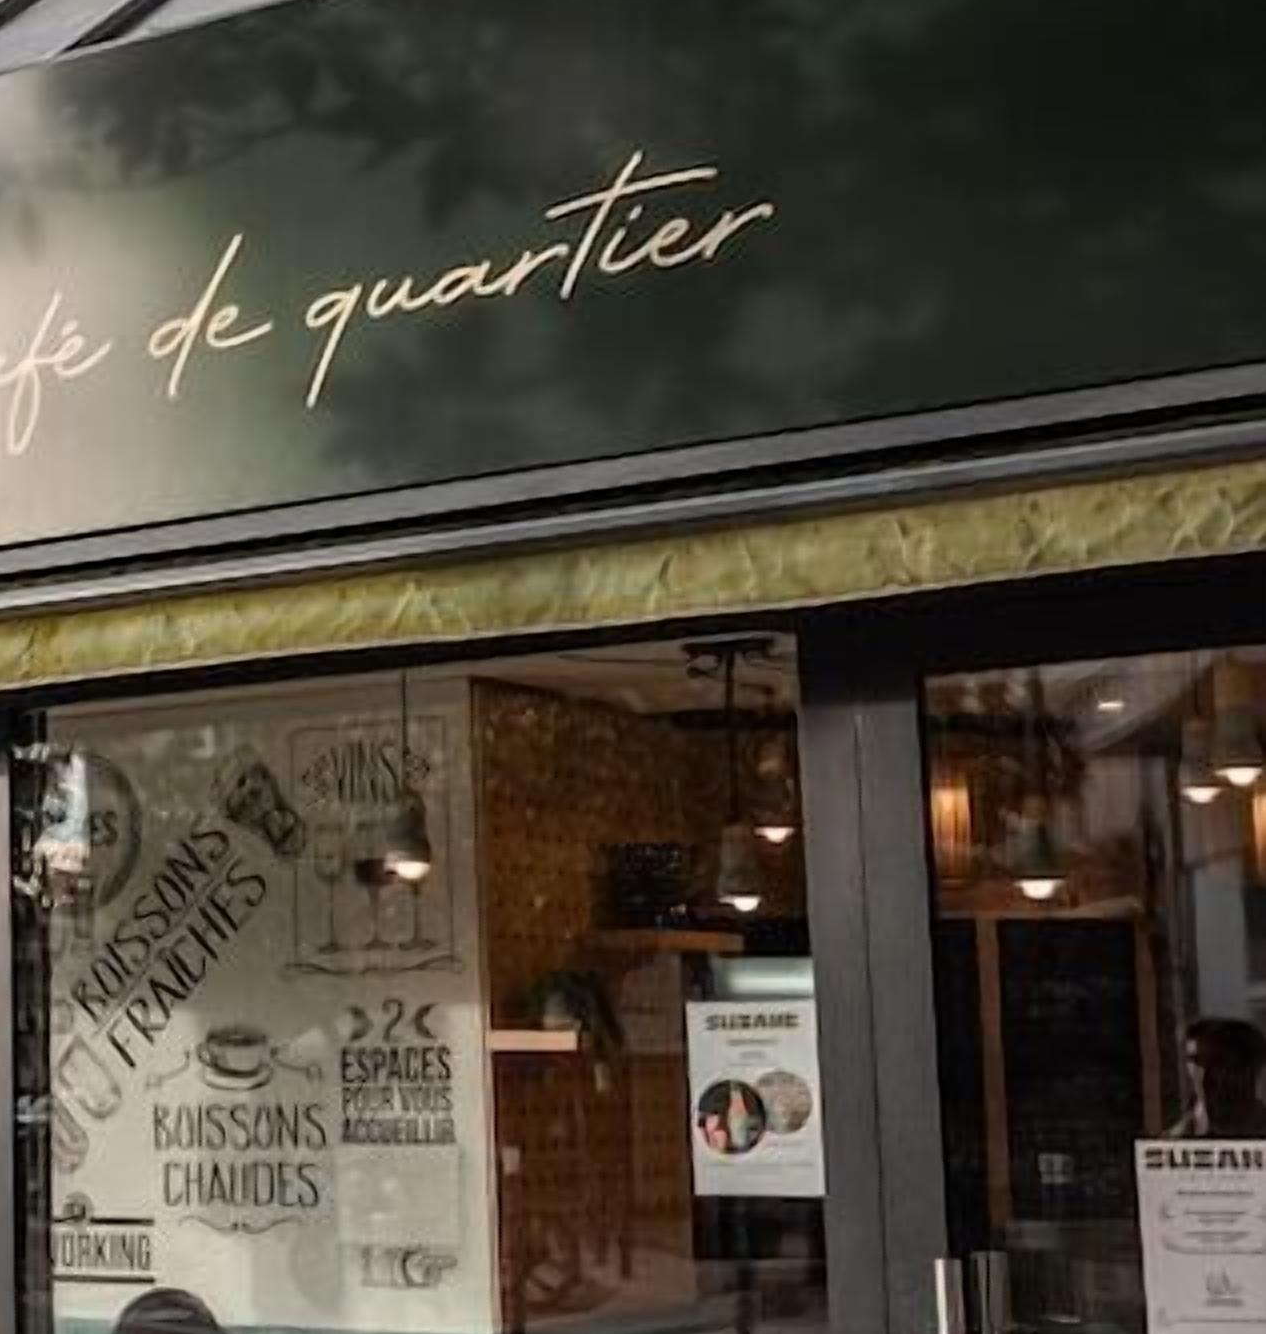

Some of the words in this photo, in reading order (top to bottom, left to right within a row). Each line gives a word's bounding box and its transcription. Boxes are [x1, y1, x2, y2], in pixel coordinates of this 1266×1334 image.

[148, 234, 271, 397] de
[305, 152, 774, 407] quartier
[71, 816, 231, 1023] BOISSONS
[705, 1012, 799, 1030] SUZANE
[342, 1046, 451, 1083] ESPACES
[153, 1101, 327, 1151] BOISSONS
[1145, 1148, 1266, 1170] SUZAN
[163, 1162, 319, 1207] CHAUDES
